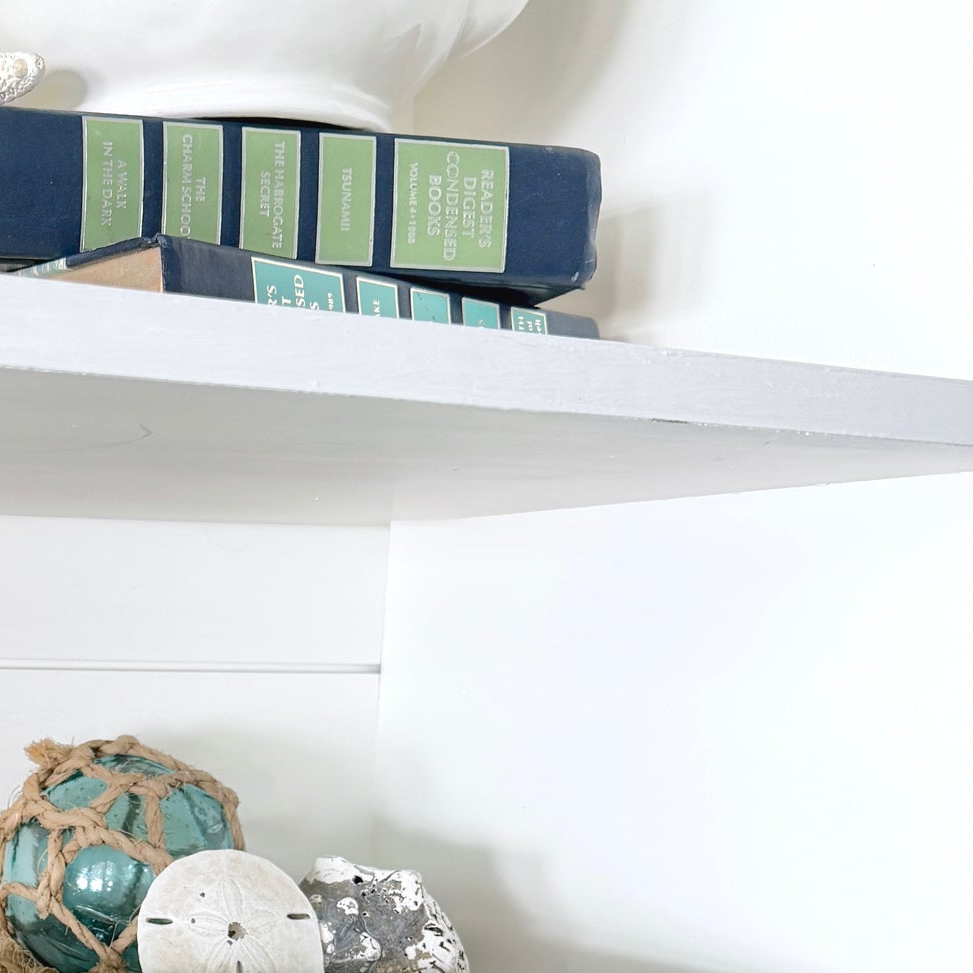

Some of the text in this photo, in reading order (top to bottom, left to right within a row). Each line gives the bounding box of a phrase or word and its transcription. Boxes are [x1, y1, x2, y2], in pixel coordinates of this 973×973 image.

[101, 141, 113, 226] IN THE DARK
[116, 159, 128, 209] A WALK
[179, 134, 193, 239] CHARM SCHOO
[195, 177, 206, 202] THE
[259, 171, 271, 217] SECRET
[272, 141, 285, 249] THE HARROGATE
[409, 162, 419, 206] VOLUME
[427, 174, 441, 237] BOOKS
[443, 151, 460, 262] CONDENSED
[462, 176, 476, 238] DIGEST
[478, 169, 494, 248] READER'S
